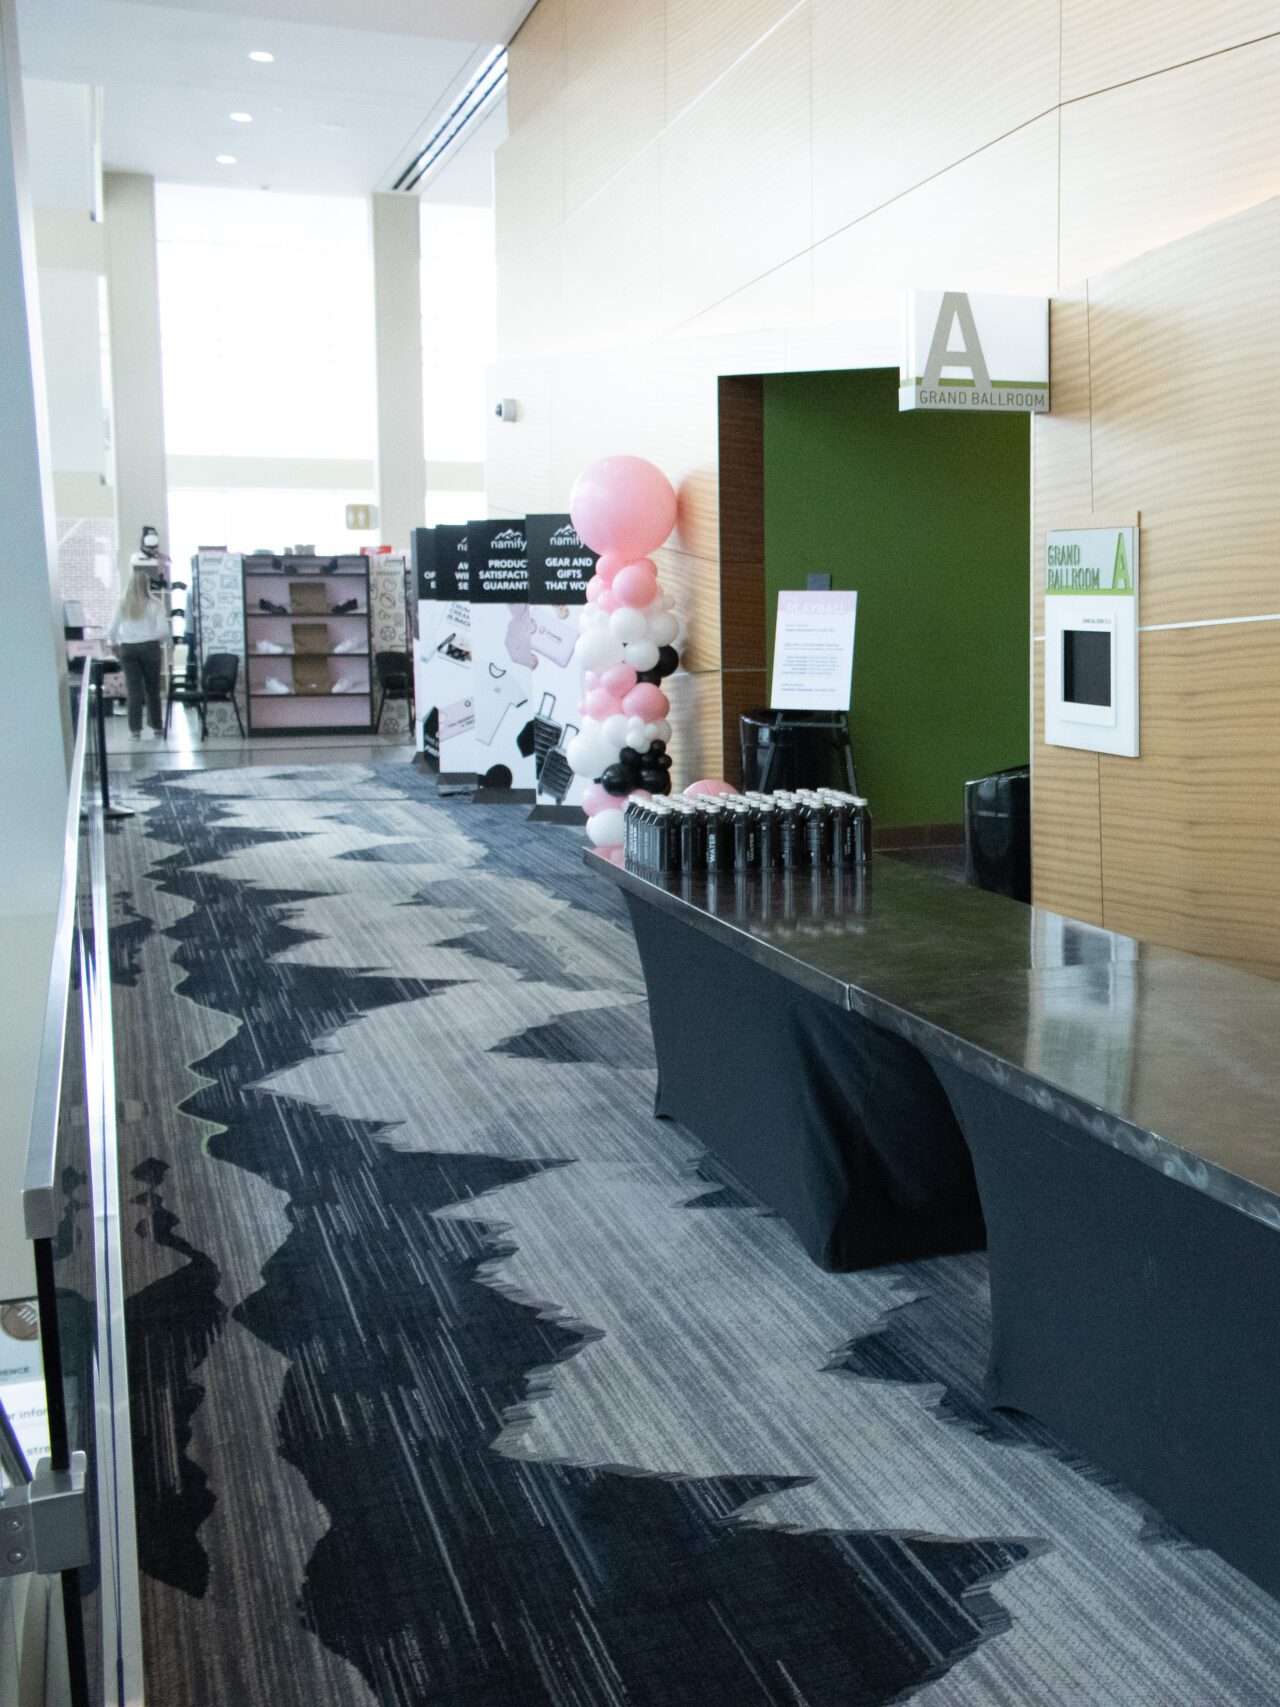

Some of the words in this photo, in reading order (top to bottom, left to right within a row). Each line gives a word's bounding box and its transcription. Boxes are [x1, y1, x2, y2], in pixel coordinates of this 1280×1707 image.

[920, 291, 993, 387] A
[919, 390, 967, 405] GRAND
[971, 391, 1046, 407] BALLROOM
[490, 536, 527, 552] namify
[1047, 544, 1080, 566] GRAND
[1111, 532, 1130, 590] A
[488, 559, 528, 569] PRODUC
[545, 557, 570, 568] GEAR
[572, 557, 593, 568] AND
[478, 570, 529, 580] SATISFACTI
[557, 569, 582, 579] GIFTS
[1047, 567, 1100, 591] BALLROOM
[482, 581, 529, 591] GUARANT
[544, 580, 568, 591] THAT
[569, 580, 589, 591] WO
